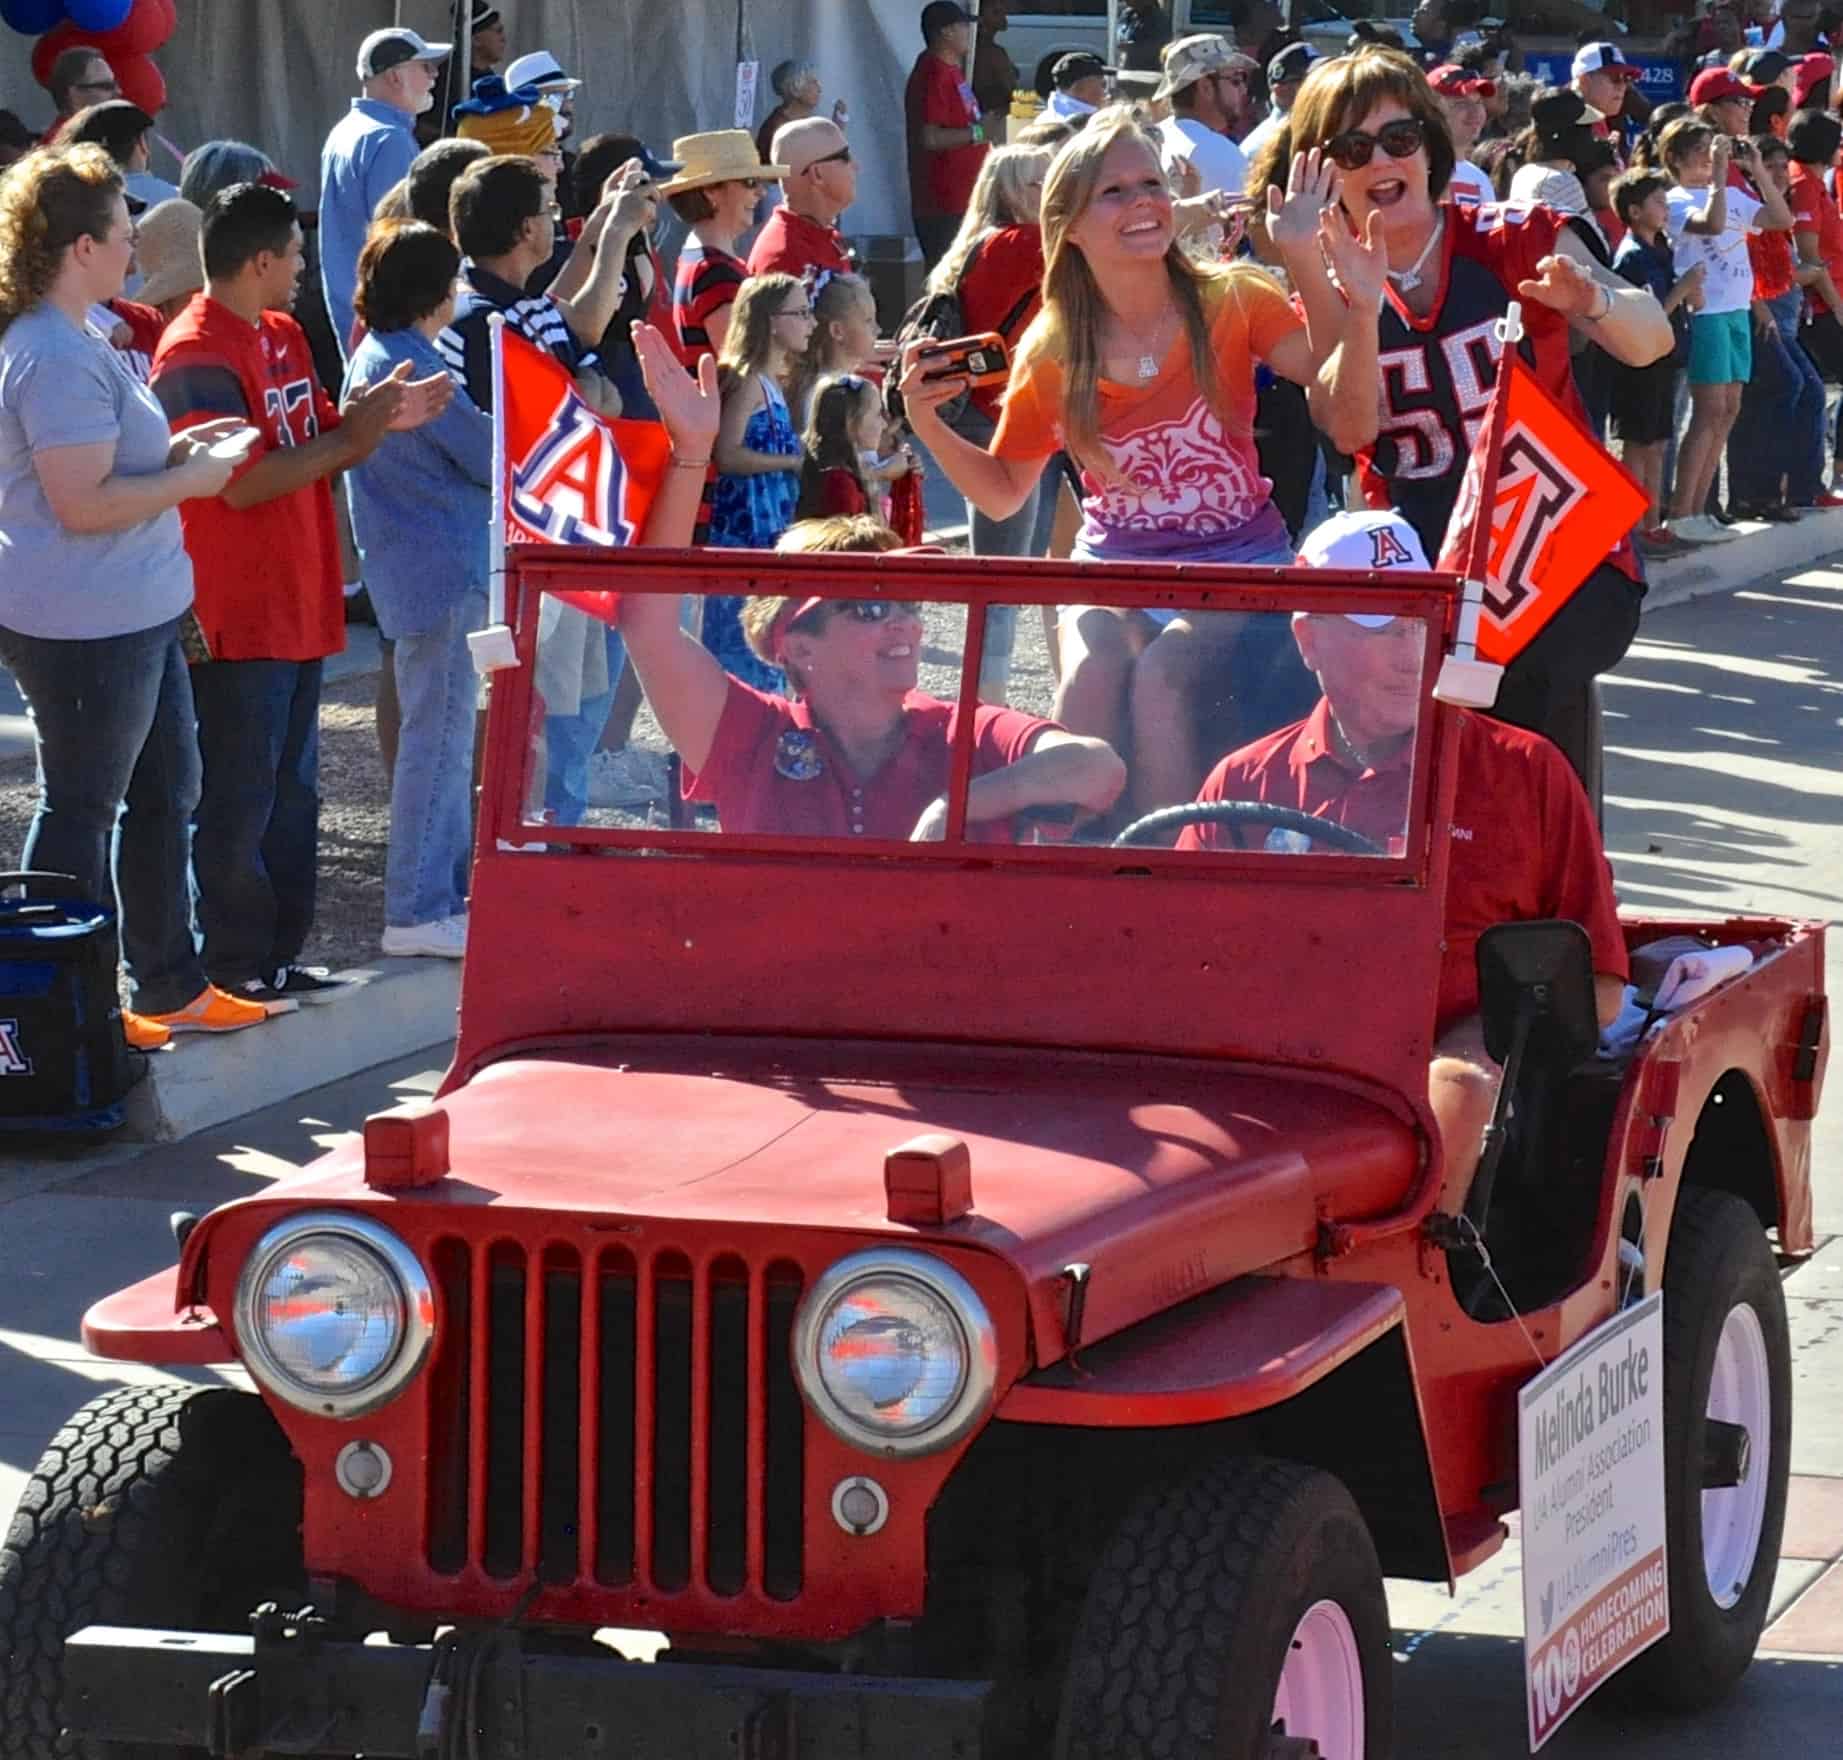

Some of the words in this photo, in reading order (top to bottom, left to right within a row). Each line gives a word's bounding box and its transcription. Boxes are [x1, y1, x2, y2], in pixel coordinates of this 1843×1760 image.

[509, 383, 636, 545] A
[1366, 526, 1414, 569] A
[1535, 1372, 1595, 1480] Melinda
[1599, 1338, 1649, 1425] Burke
[1551, 1462, 1585, 1513] Alumni
[1587, 1417, 1650, 1480] Association
[1564, 1482, 1615, 1544] President
[1580, 1560, 1663, 1648] HOMECOMING
[1581, 1591, 1664, 1677] CELEBRATION
